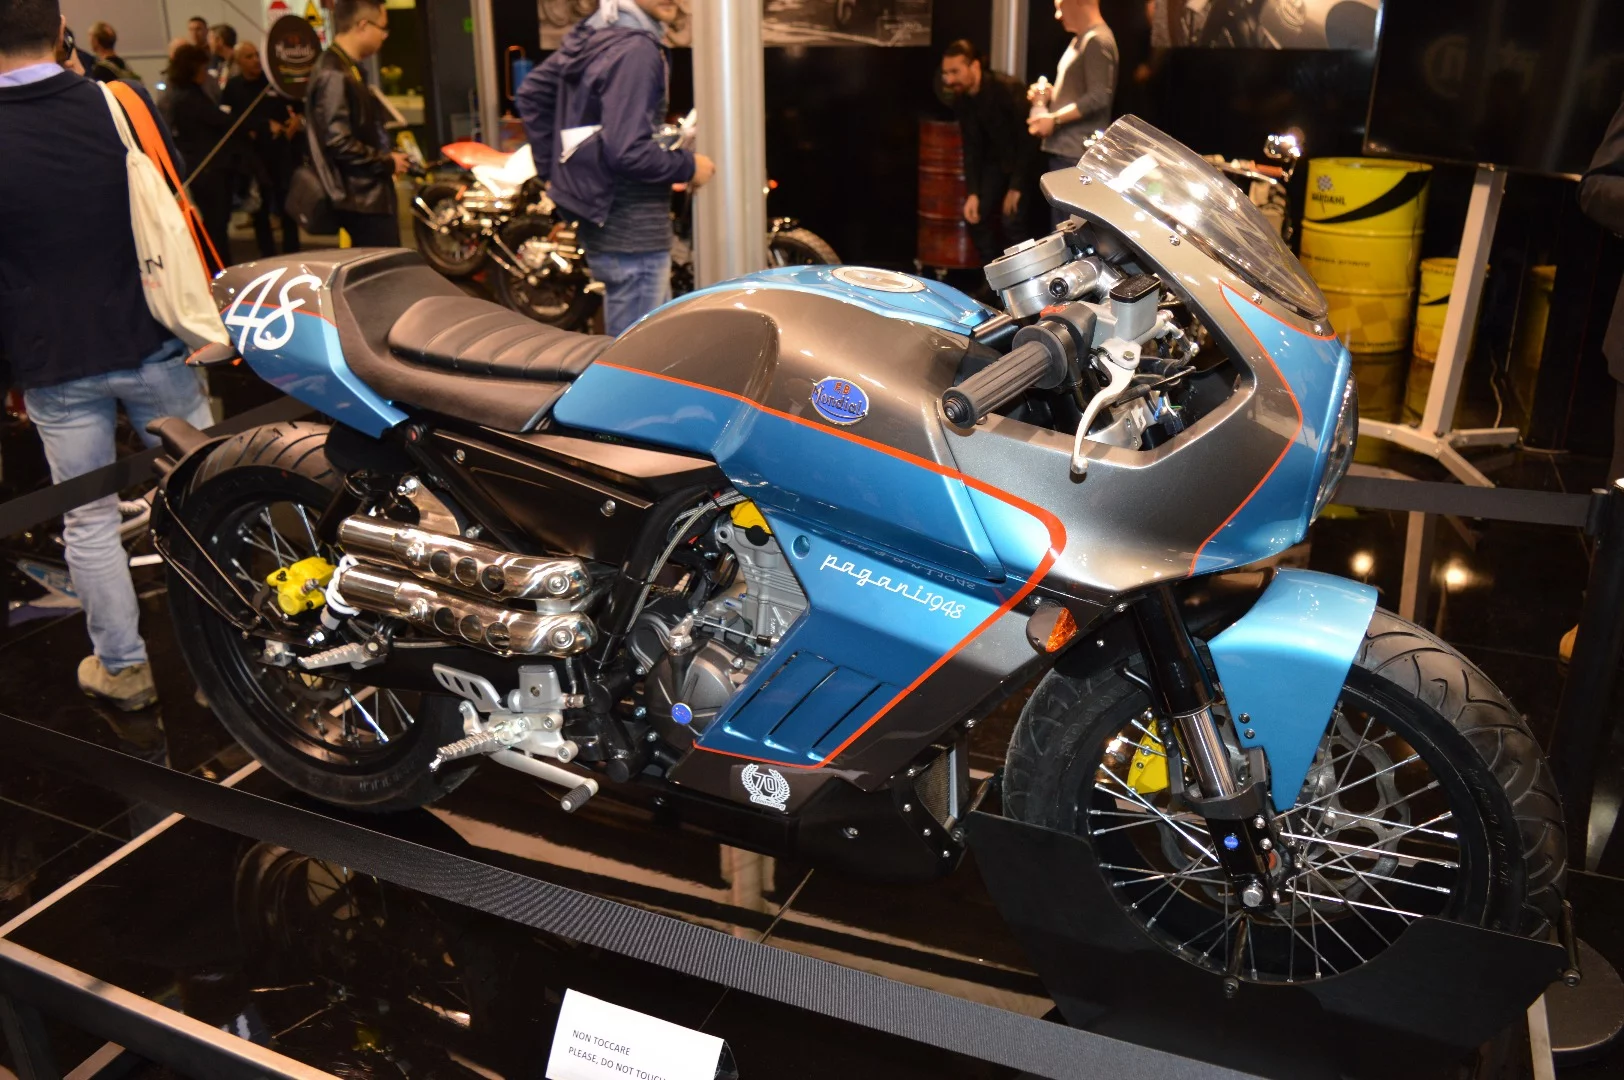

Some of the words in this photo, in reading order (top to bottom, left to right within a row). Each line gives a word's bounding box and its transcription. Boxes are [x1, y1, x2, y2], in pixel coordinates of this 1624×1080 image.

[225, 267, 322, 355] 48
[752, 772, 778, 794] 70
[572, 1029, 592, 1043] NON
[593, 1036, 631, 1056] TOCCARE
[568, 1046, 599, 1065] PLEASE,
[600, 1057, 614, 1069] DO
[615, 1063, 634, 1075] NOT
